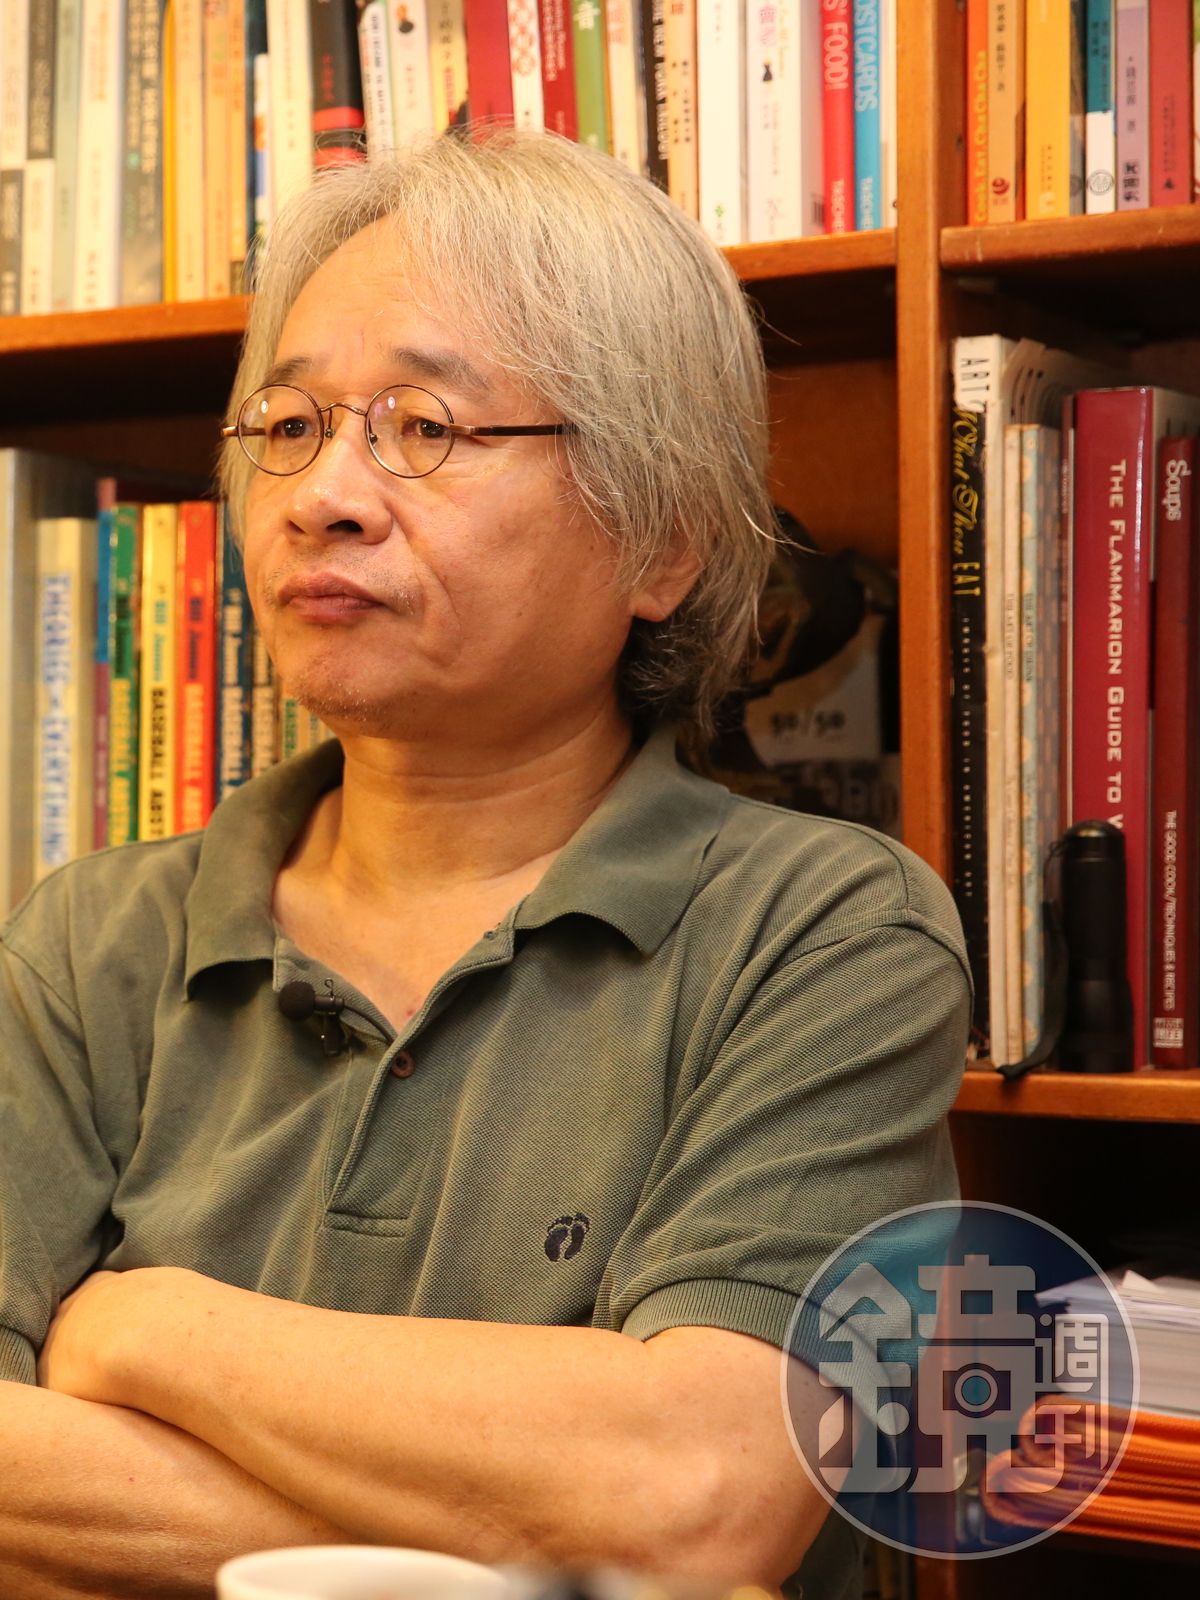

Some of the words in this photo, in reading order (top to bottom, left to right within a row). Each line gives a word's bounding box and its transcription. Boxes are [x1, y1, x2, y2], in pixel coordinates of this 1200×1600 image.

[825, 21, 849, 90] FOOD!
[831, 178, 845, 233] TASCHE
[860, 176, 873, 229] TASCHE
[960, 356, 990, 393] ART
[1109, 459, 1127, 508] THE
[1165, 458, 1191, 521] Soups
[953, 561, 981, 597] EAT
[1108, 519, 1126, 676] FLAMMARION
[150, 687, 167, 782] BASEBALL
[1107, 686, 1125, 762] GUIDE
[1107, 771, 1123, 803] TO
